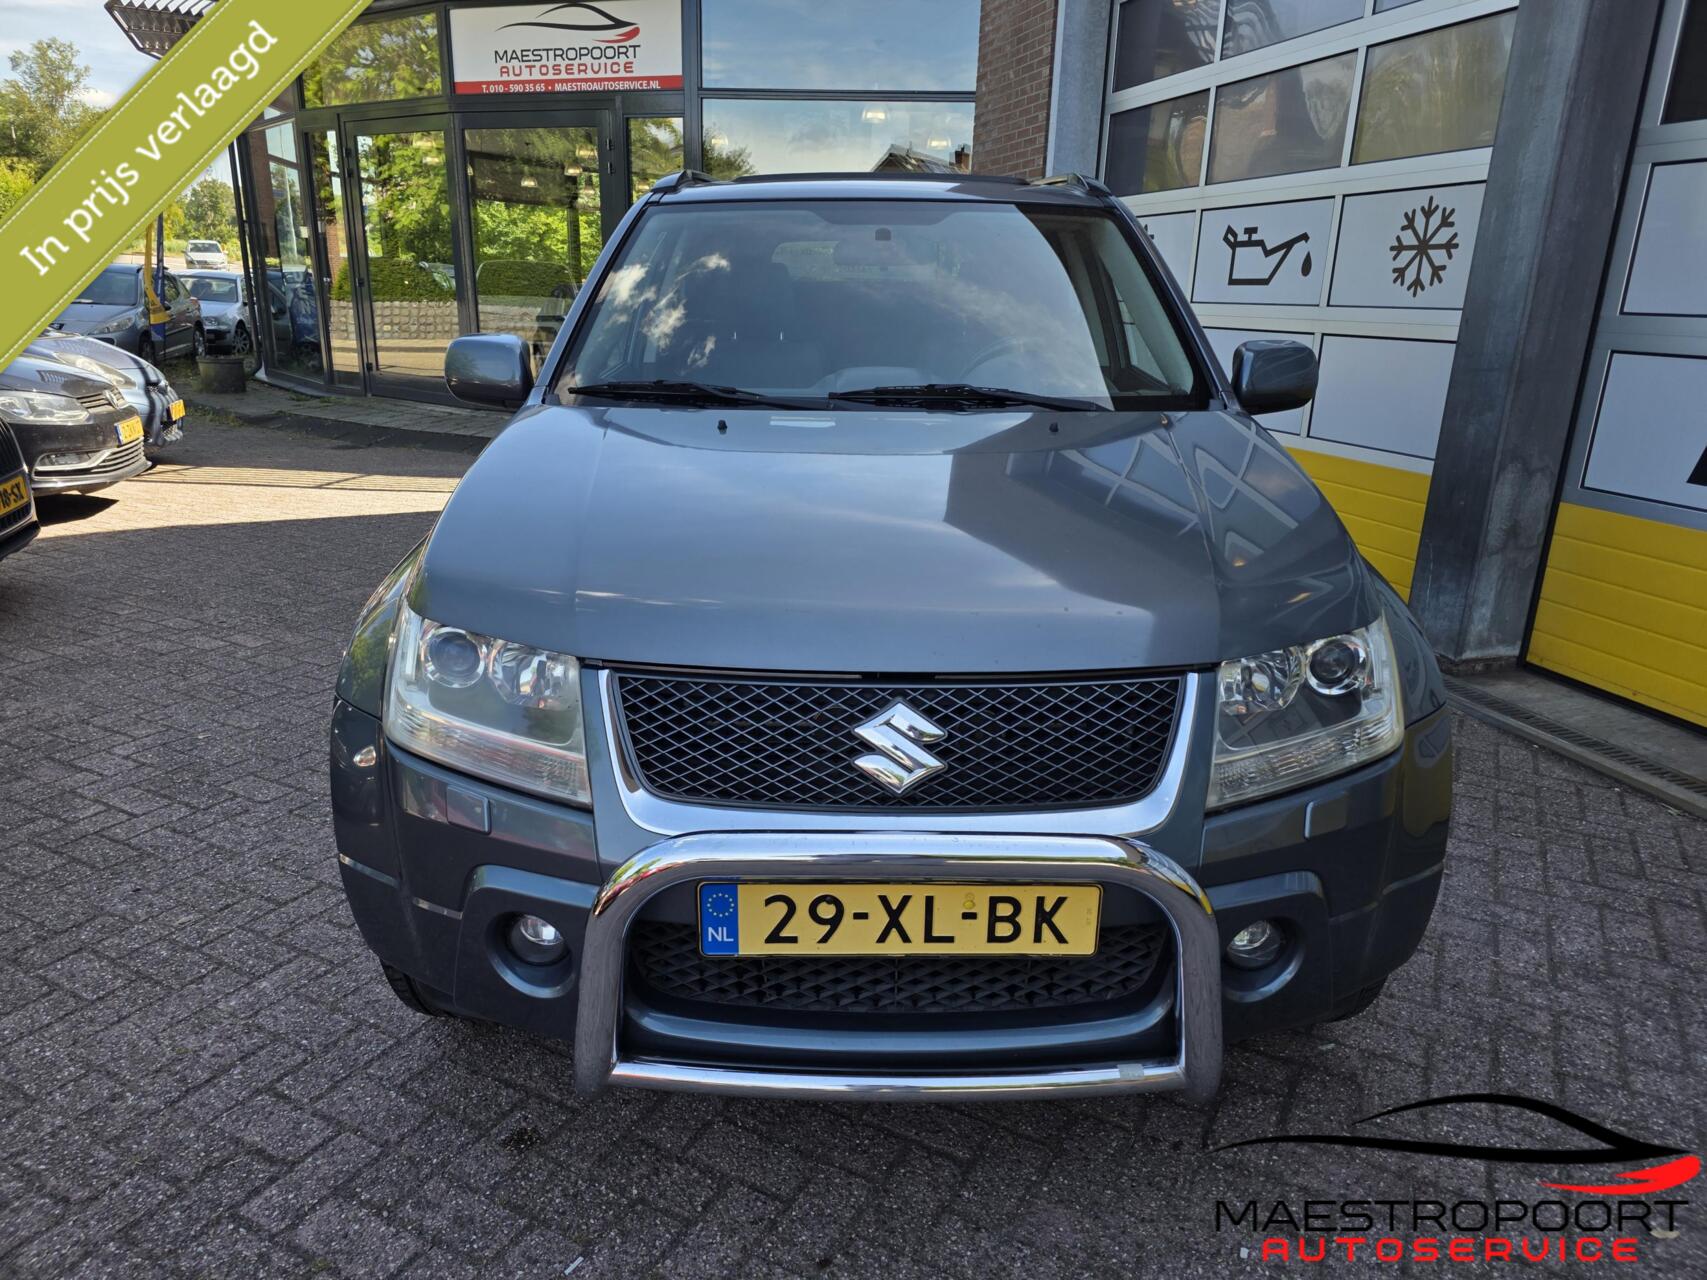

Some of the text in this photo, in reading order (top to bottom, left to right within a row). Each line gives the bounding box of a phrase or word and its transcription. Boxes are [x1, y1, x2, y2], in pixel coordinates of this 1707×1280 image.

[494, 44, 641, 64] MAESTROPOORT
[500, 61, 635, 77] AUTOSERVICE
[554, 80, 661, 92] MAESTROAUTOSERVICE.NL
[764, 895, 1069, 944] 29-XL-BK
[708, 926, 734, 942] NL
